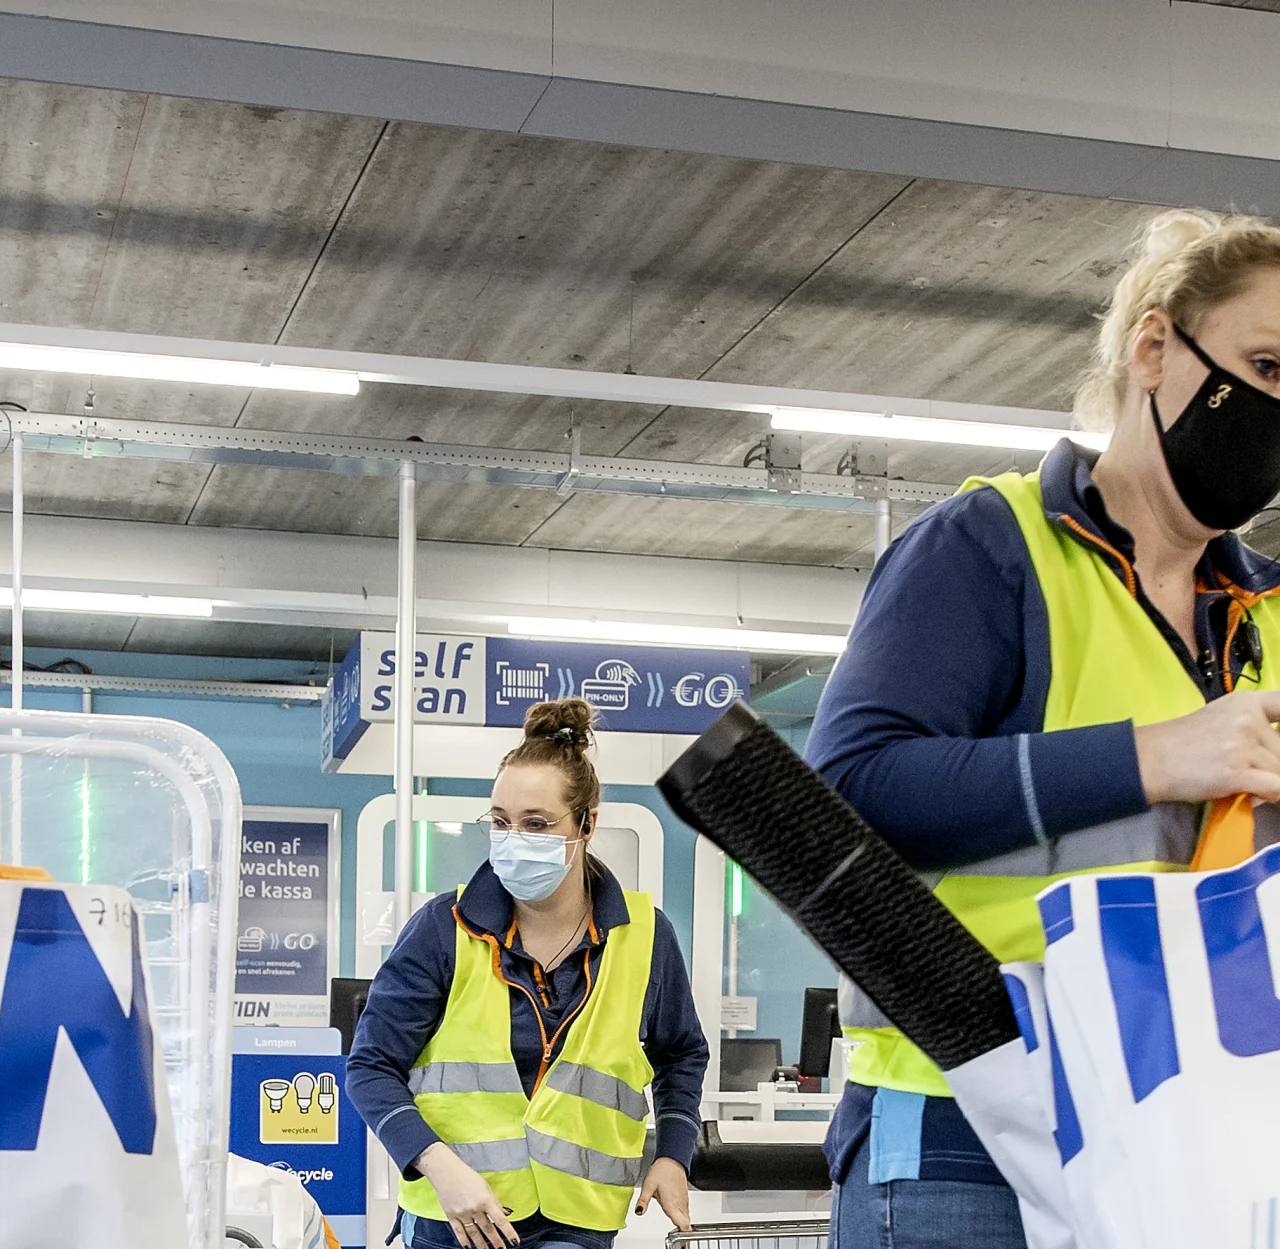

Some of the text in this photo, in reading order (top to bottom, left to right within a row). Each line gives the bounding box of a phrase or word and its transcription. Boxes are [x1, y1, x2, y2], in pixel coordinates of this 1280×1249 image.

[586, 671, 739, 708] PIN-ONLY GO
[370, 685, 467, 714] san
[281, 837, 301, 854] af
[240, 859, 320, 877] wachten
[261, 881, 312, 900] kassa
[255, 1037, 297, 1048] Lampen
[287, 1167, 334, 1185] ecycle
